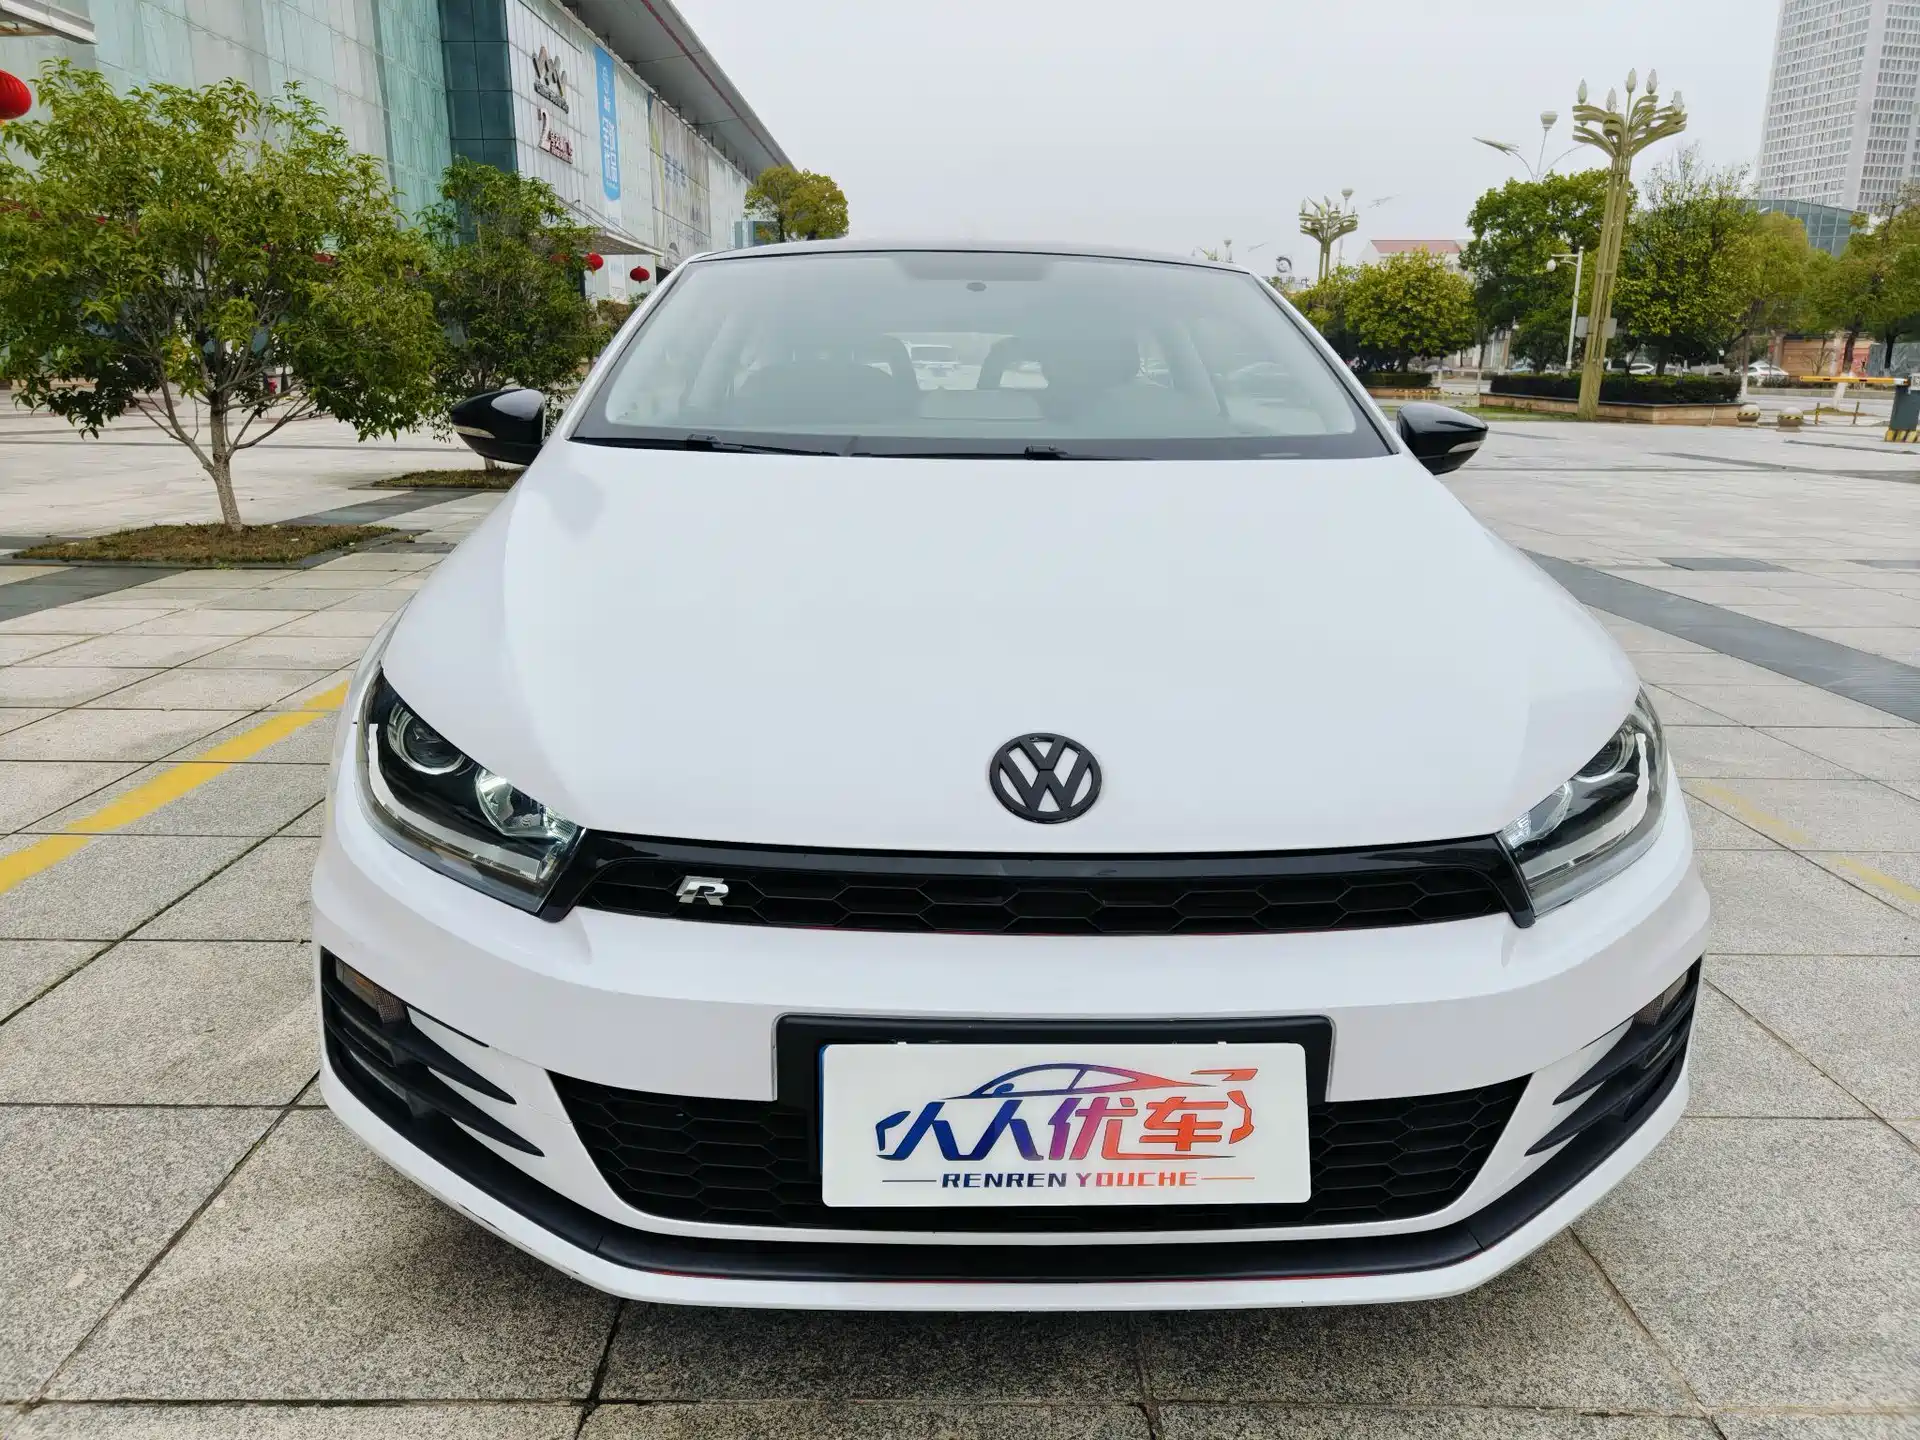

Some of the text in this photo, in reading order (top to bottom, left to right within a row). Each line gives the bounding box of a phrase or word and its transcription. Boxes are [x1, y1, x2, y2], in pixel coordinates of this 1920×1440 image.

[676, 876, 729, 906] R
[876, 1096, 1230, 1162] 人人优车
[941, 1171, 1198, 1188] RENREN YOUCHE
